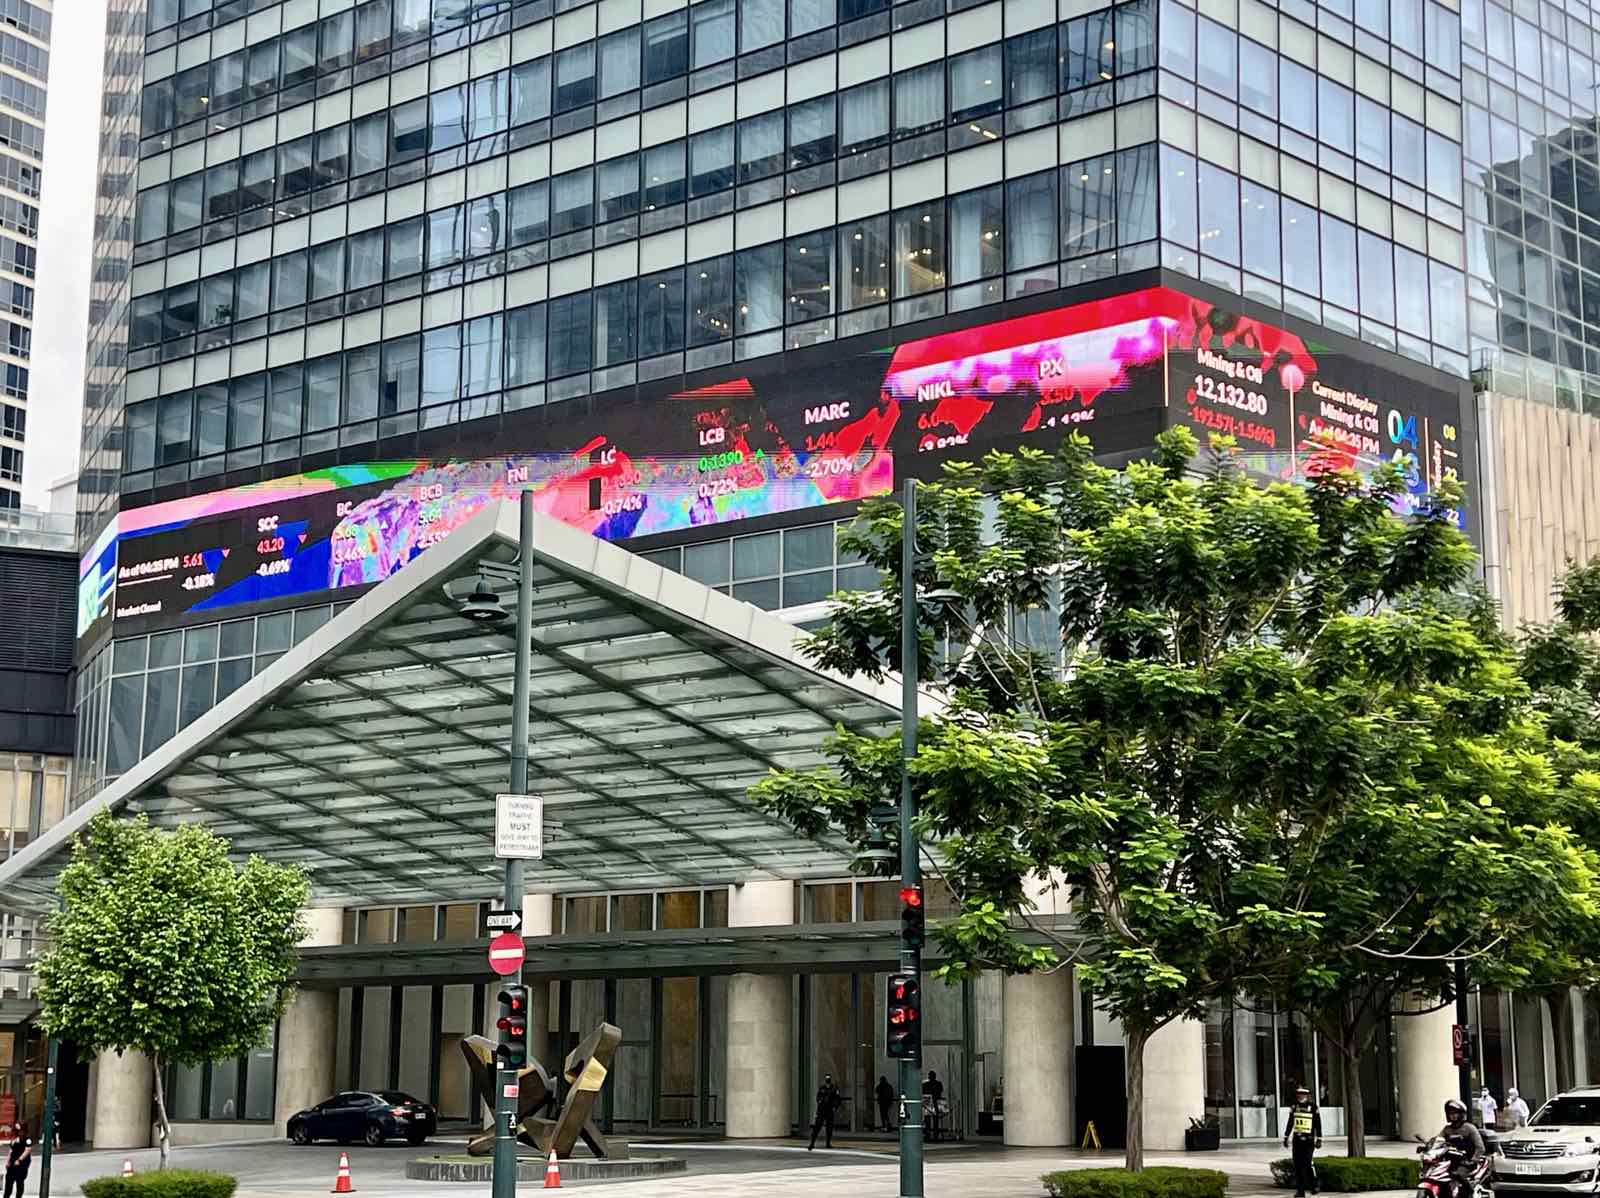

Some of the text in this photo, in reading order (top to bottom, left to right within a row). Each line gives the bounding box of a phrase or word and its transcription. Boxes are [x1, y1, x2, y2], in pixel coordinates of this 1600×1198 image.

[1040, 357, 1064, 378] PX
[1197, 347, 1234, 377] Mining
[1235, 361, 1244, 379] &
[918, 380, 955, 402] NIKL
[1194, 374, 1267, 416] 12,132.80
[1312, 381, 1378, 416] Current Display
[805, 401, 850, 424] MARC
[1319, 401, 1353, 429] Mining
[1354, 413, 1363, 430] &
[699, 427, 725, 446] LCB
[1387, 409, 1418, 449] 04
[1361, 436, 1380, 455] PM
[601, 447, 616, 465] LC
[506, 467, 528, 484] FNI
[805, 457, 853, 478] -2.70%
[419, 484, 443, 501] BCB
[698, 476, 738, 498] 0.72%
[336, 502, 352, 517] BC
[600, 494, 642, 515] -0.74%
[257, 516, 279, 532] SCC
[256, 536, 284, 554] 43.20
[164, 556, 179, 571] PM
[183, 553, 203, 569] 5.61
[509, 823, 530, 832] MUST
